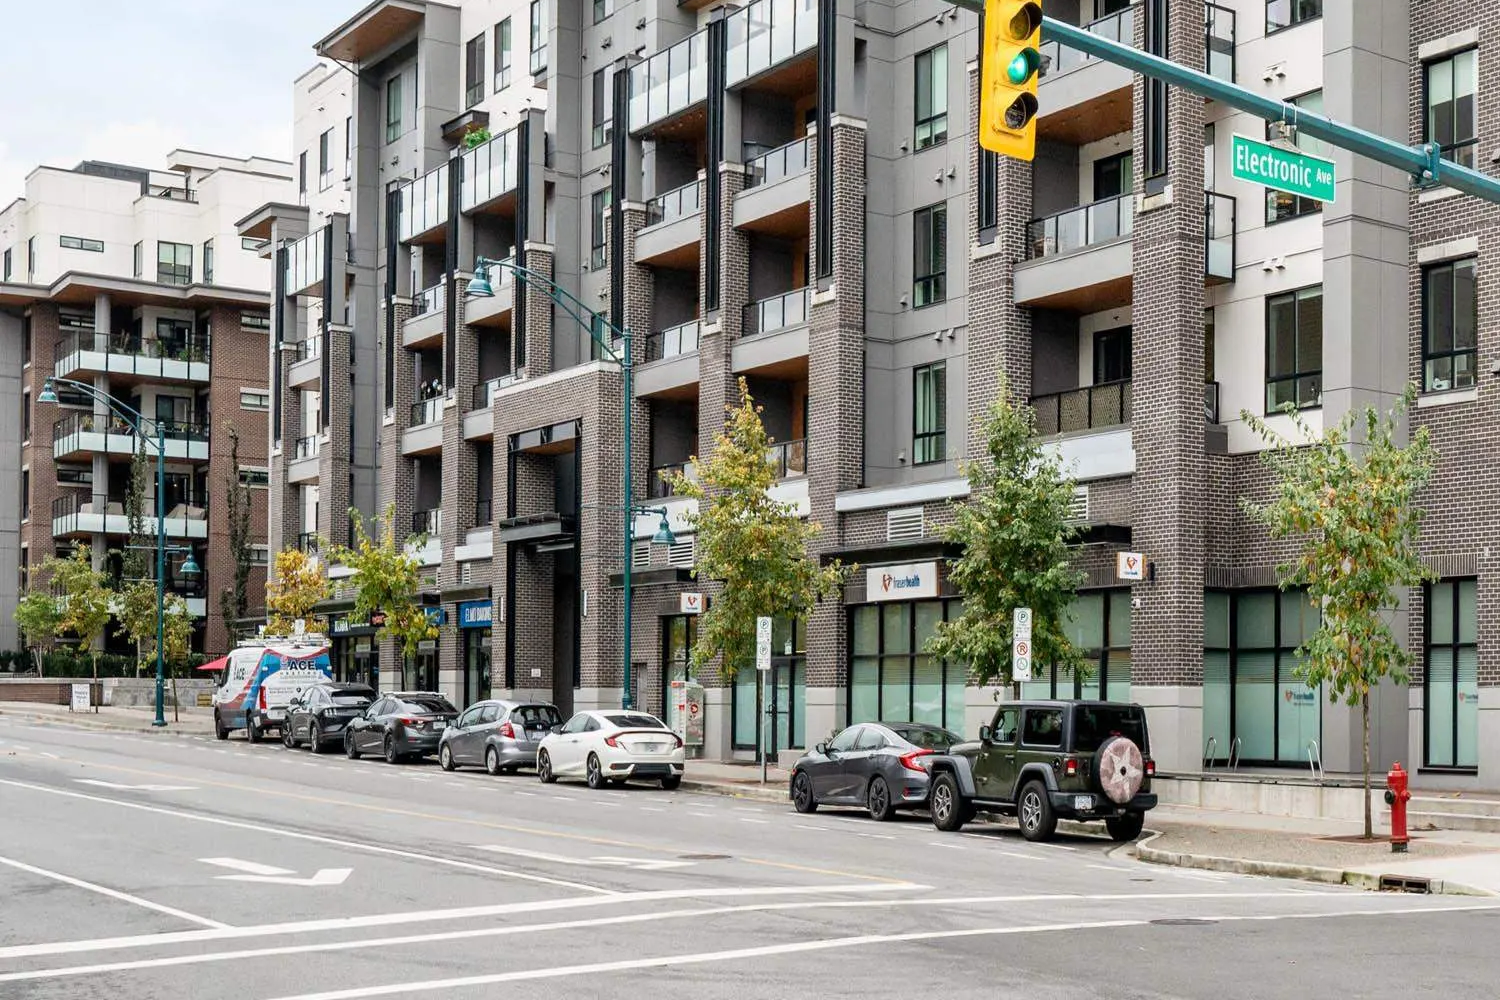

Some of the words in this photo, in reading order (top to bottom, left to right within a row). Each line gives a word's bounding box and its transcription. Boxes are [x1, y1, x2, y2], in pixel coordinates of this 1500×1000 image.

[1236, 144, 1312, 188] Electronic
[1316, 167, 1332, 185] Ave
[289, 660, 316, 671] ACE
